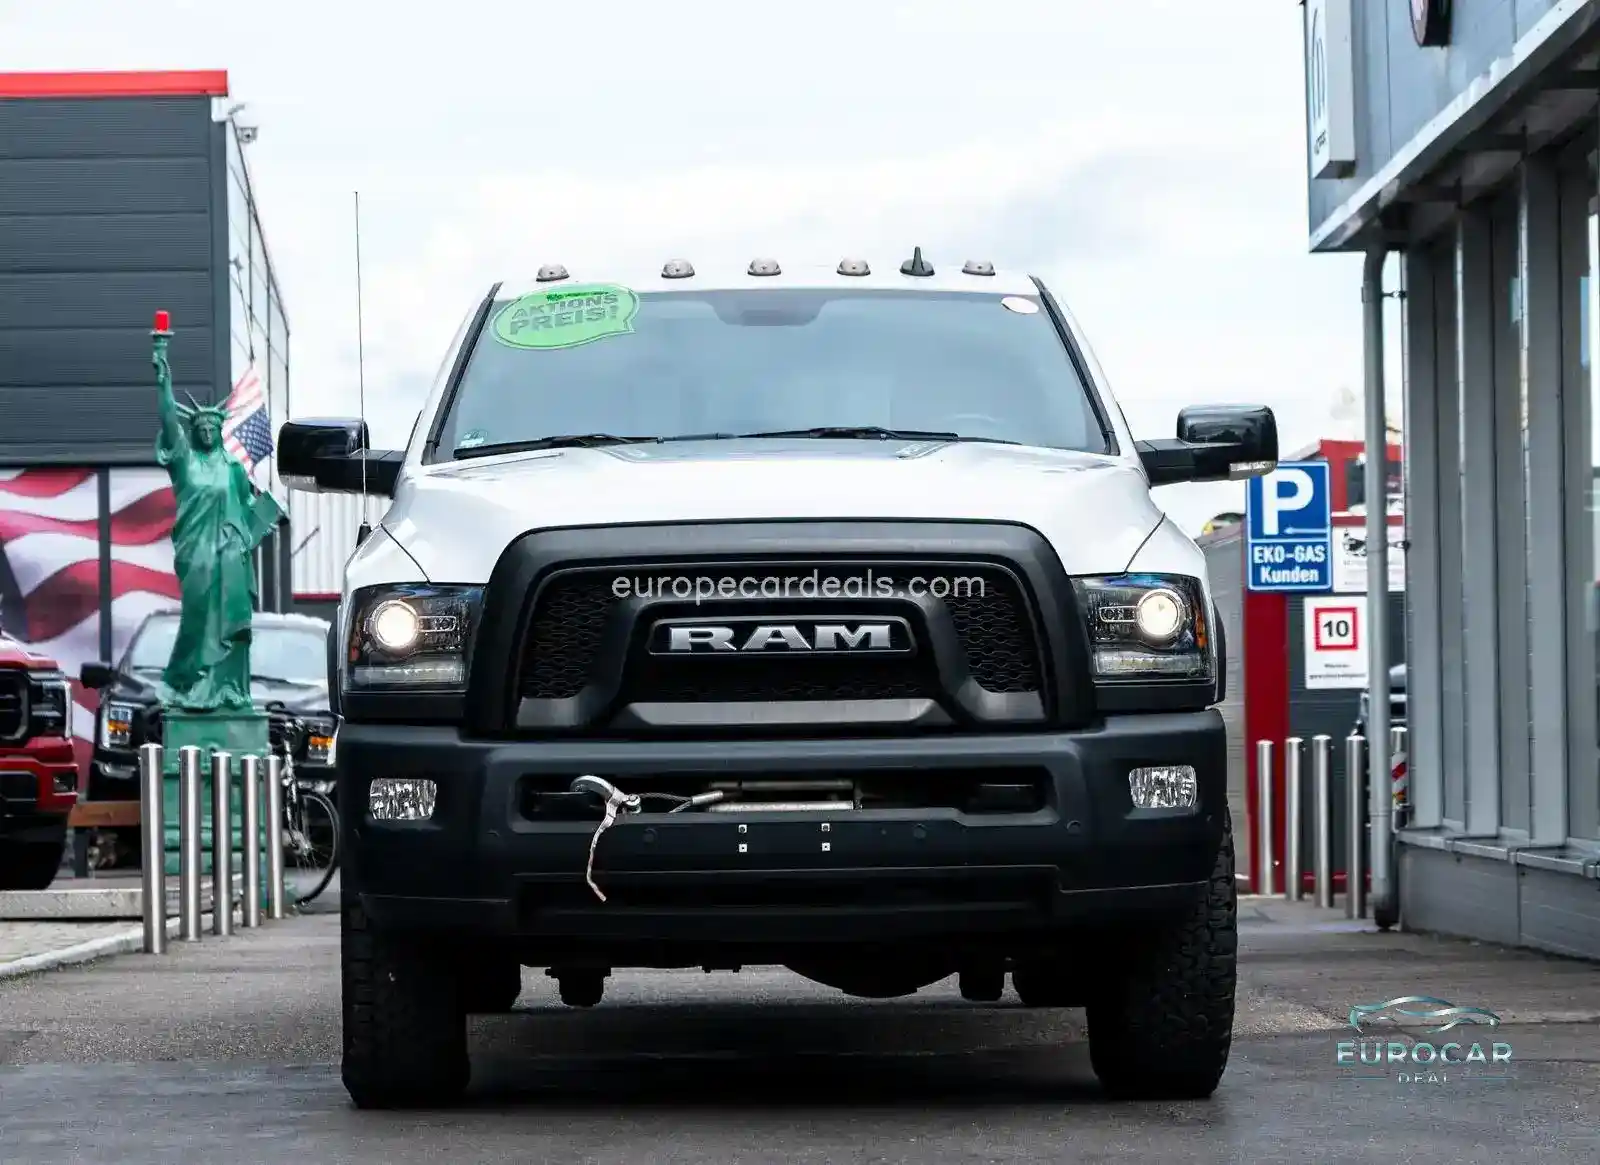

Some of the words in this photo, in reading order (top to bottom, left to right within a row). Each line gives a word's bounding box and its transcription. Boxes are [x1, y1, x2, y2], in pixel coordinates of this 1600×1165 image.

[510, 305, 618, 335] PREIS!
[512, 293, 618, 320] AKTIONS
[1262, 468, 1314, 535] P
[1253, 544, 1326, 564] EKO-GAS
[1260, 566, 1319, 584] Kunden
[668, 624, 891, 652] RAM
[1323, 620, 1350, 638] 10
